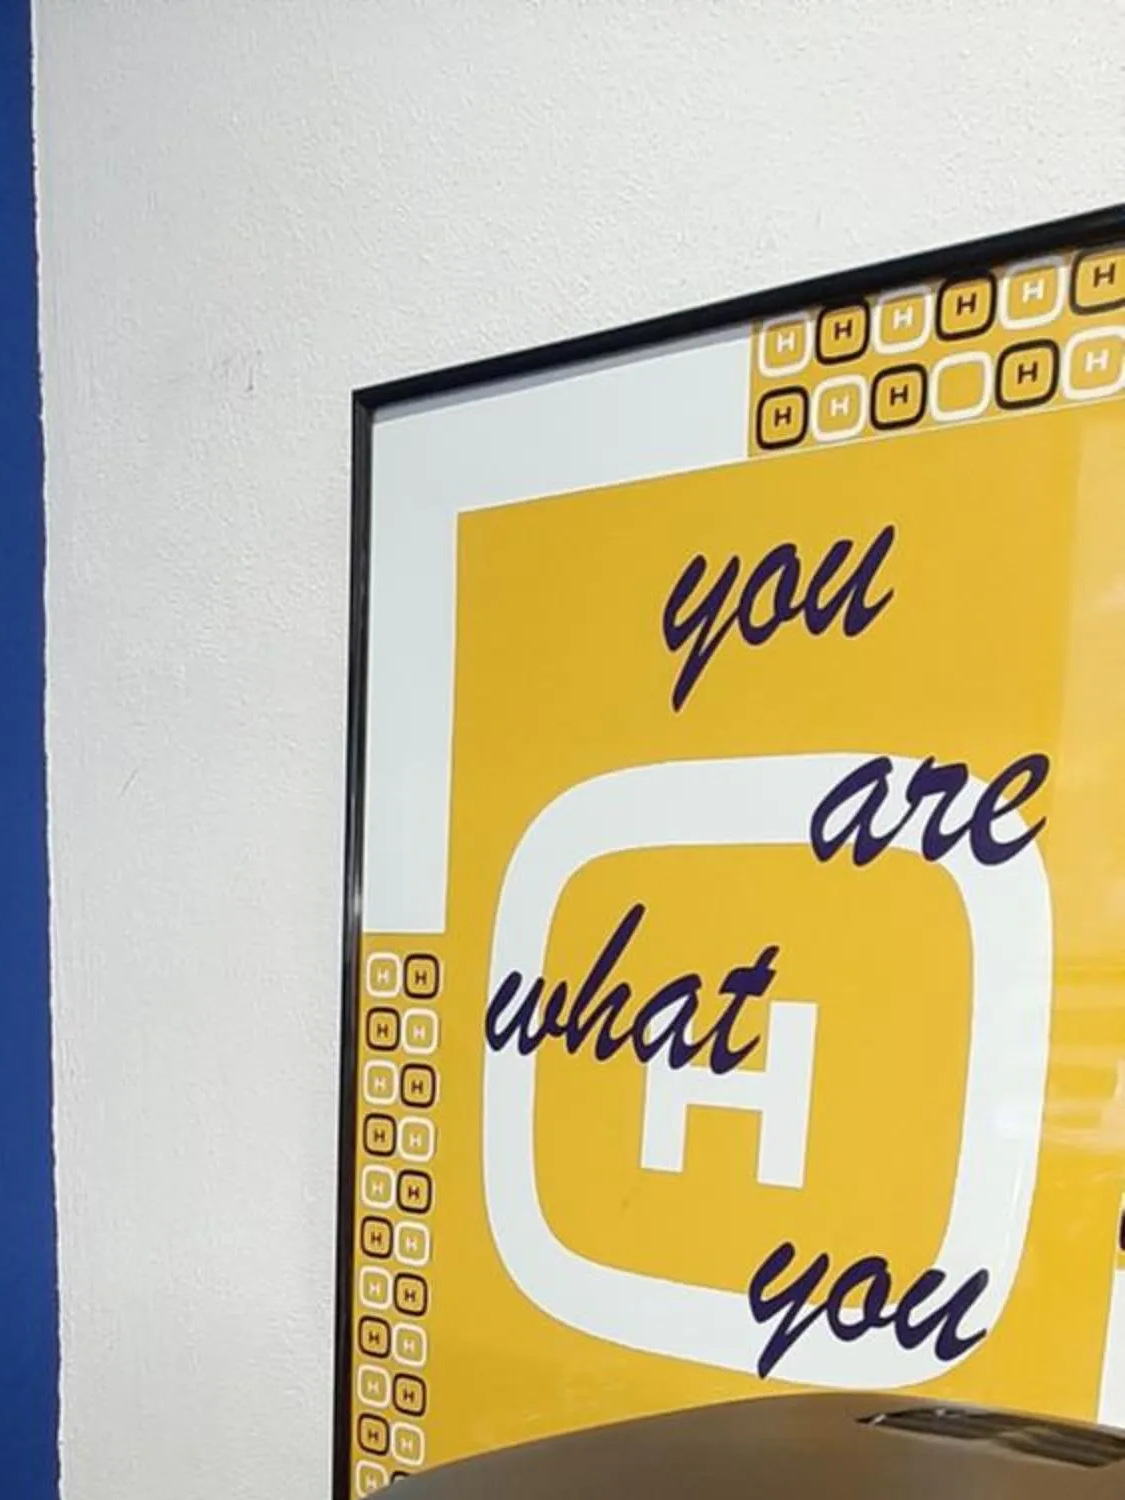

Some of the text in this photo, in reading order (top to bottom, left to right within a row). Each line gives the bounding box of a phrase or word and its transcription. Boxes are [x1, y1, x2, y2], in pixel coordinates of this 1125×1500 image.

[777, 264, 1115, 352] H H H H H H
[775, 349, 1108, 427] H H H H H
[661, 524, 896, 713] you
[810, 752, 1051, 867] are
[483, 902, 780, 1076] what
[640, 1001, 818, 1189] H
[747, 1241, 989, 1380] you
